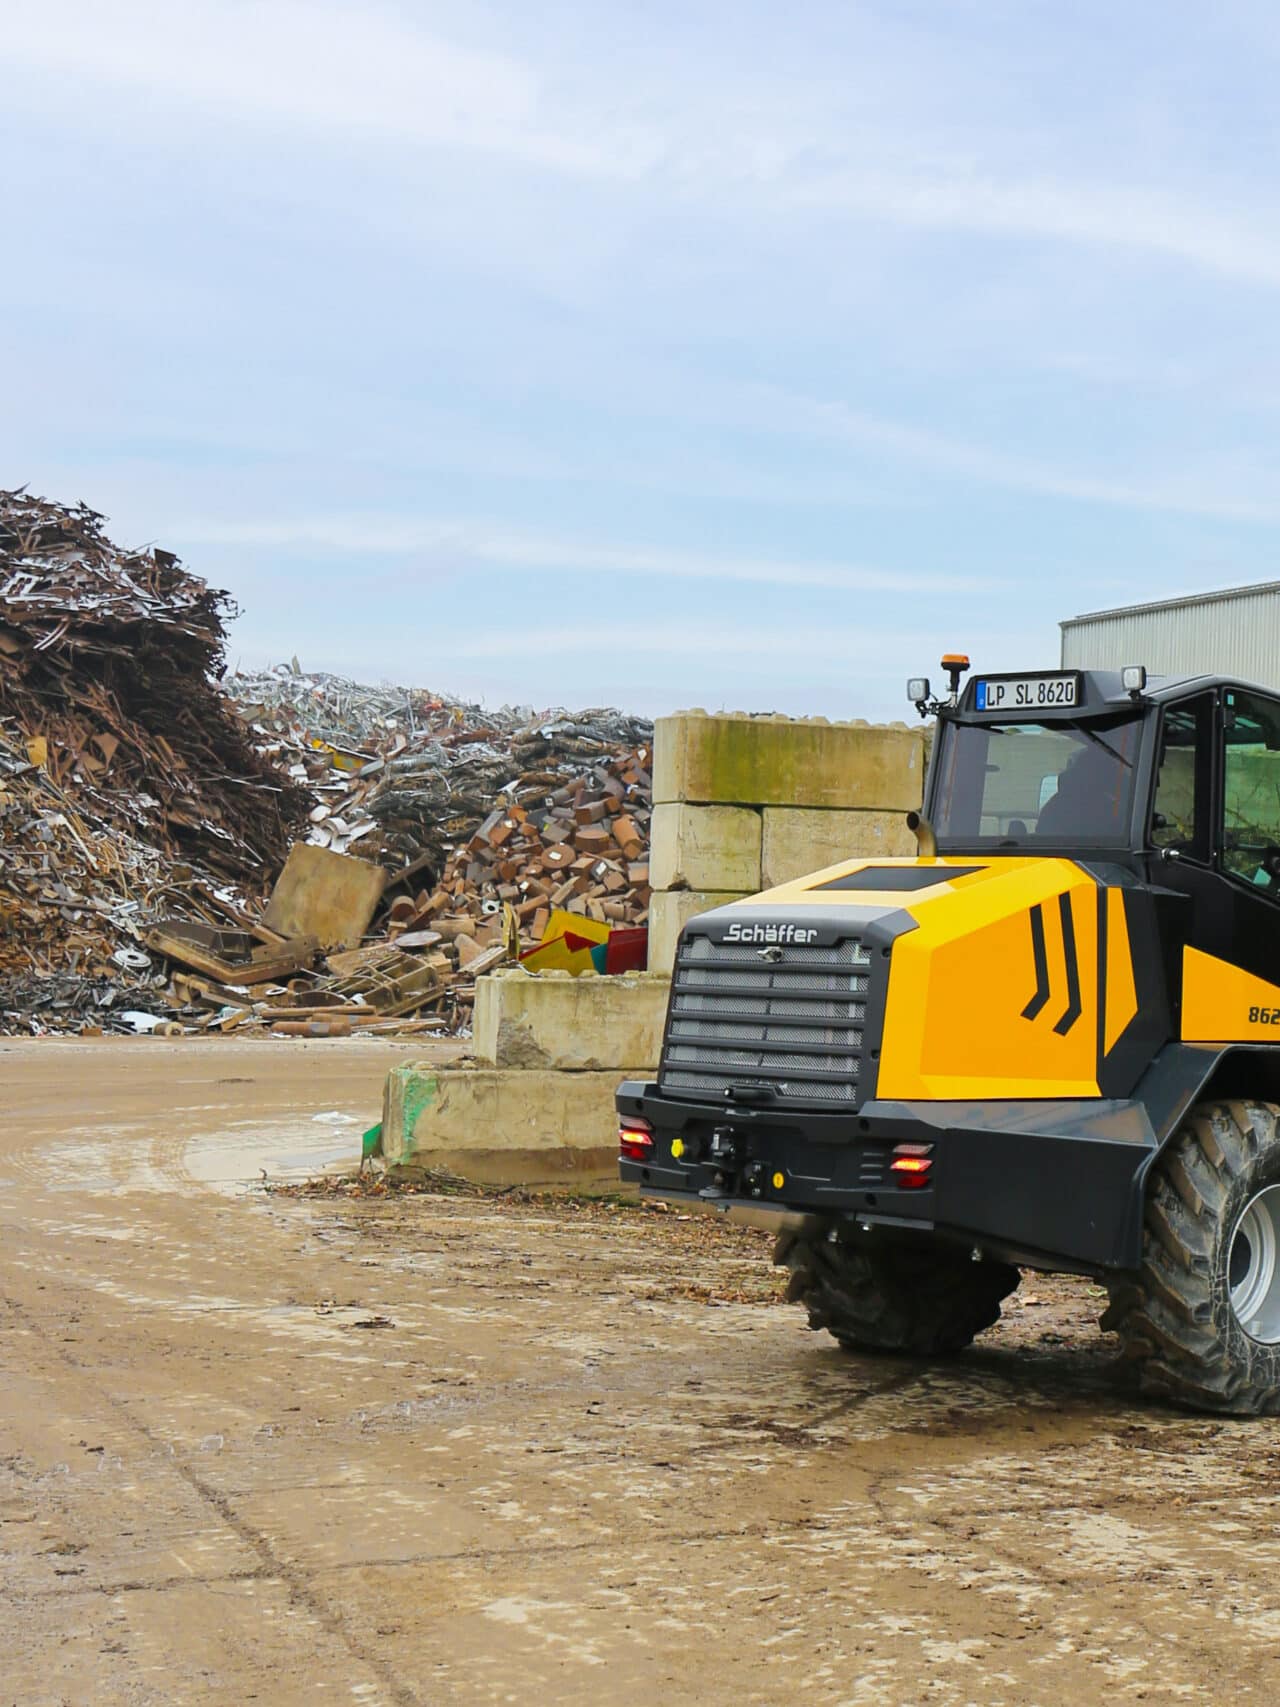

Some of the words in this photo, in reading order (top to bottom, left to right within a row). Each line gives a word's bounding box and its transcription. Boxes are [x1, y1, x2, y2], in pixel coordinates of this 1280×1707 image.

[987, 685, 1005, 706] LP
[1016, 684, 1033, 705] SL
[1038, 682, 1074, 703] 8620
[723, 923, 818, 943] Schäffer
